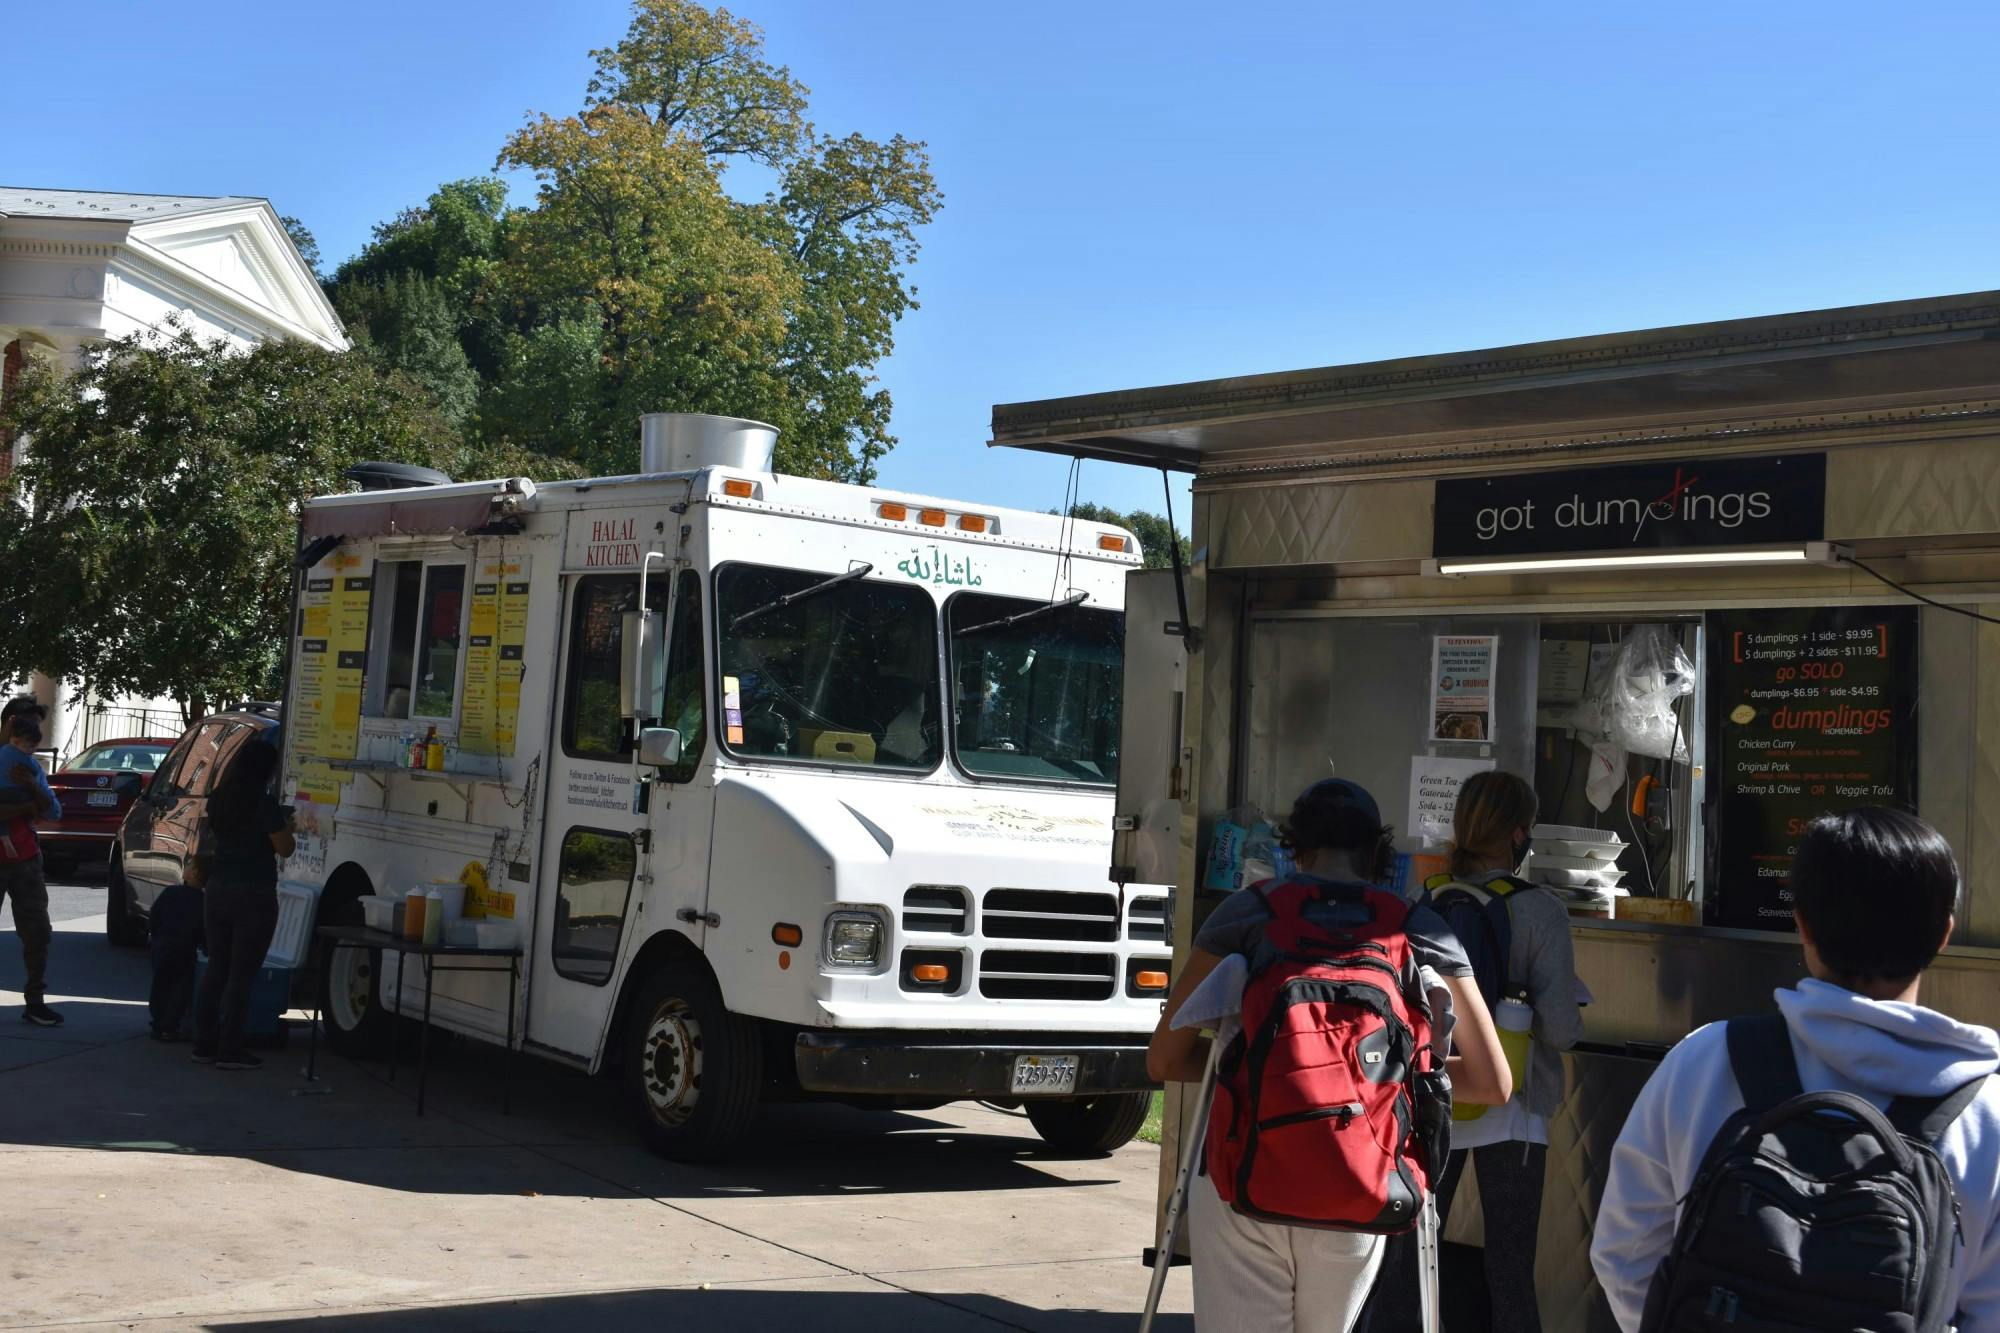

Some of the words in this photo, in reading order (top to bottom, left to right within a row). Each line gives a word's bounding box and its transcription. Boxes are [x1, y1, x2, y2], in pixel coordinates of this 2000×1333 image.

[1476, 499, 1535, 540] got
[1555, 472, 1771, 542] dumplings
[592, 518, 637, 542] HALAL
[586, 543, 641, 566] KITCHEN
[1747, 634, 1753, 644] 5
[1755, 632, 1799, 645] dumplings
[1811, 631, 1816, 642] 1
[1819, 630, 1837, 641] side
[1845, 629, 1873, 640] $9.95
[1745, 649, 1751, 660] 5
[1753, 648, 1796, 660] dumplings
[1808, 647, 1814, 657] 2
[1816, 646, 1838, 657] sides
[1775, 665, 1797, 684] go
[1800, 661, 1844, 680] SOLO
[1771, 703, 1891, 735] dumplings
[1824, 727, 1863, 735] HOMEMADE
[1738, 739, 1771, 749] Chicken
[1772, 739, 1796, 750] Curry
[1737, 762, 1769, 773] Original
[1771, 762, 1791, 772] Pork
[1420, 775, 1442, 785] Green
[1444, 776, 1458, 786] Tea
[1419, 788, 1454, 798] Gatorade
[1736, 784, 1766, 796] Shrimp
[1768, 785, 1775, 794] &
[1777, 784, 1801, 794] Chive
[1810, 785, 1825, 795] OR
[1834, 785, 1869, 797] Veggie
[1871, 785, 1894, 795] Tofu
[1418, 800, 1437, 811] Soda
[1757, 867, 1792, 877] Edama
